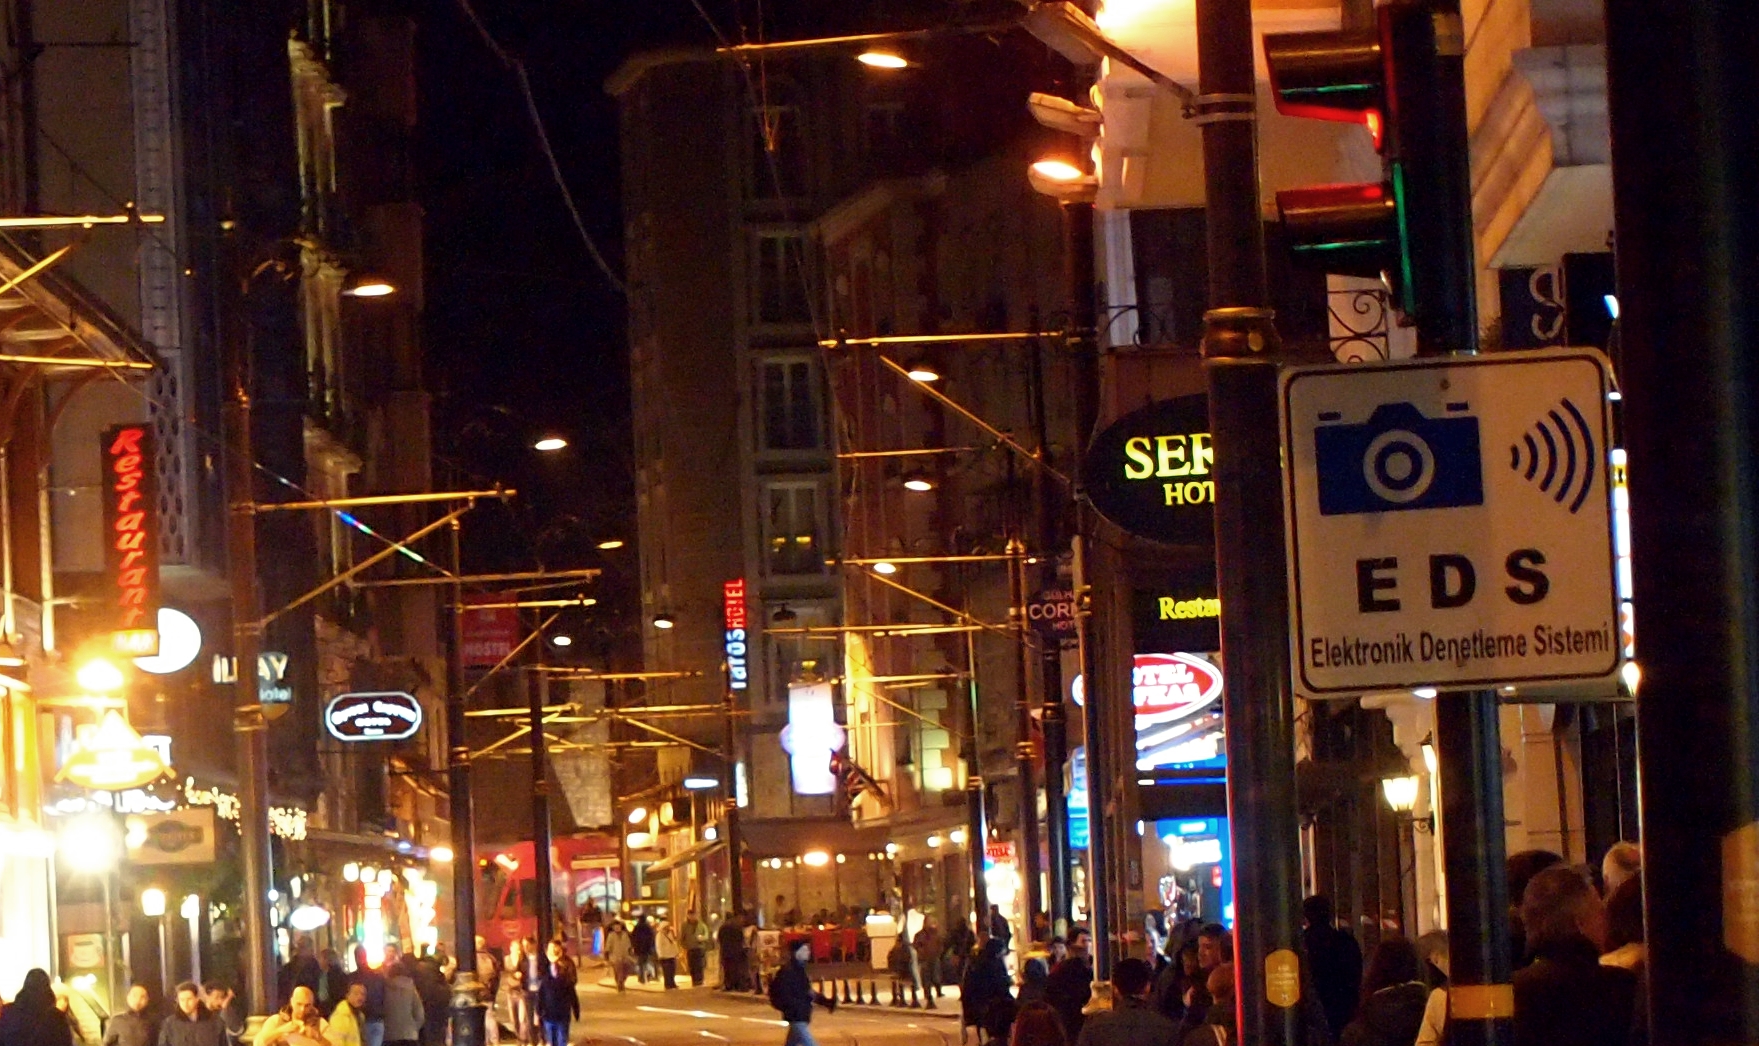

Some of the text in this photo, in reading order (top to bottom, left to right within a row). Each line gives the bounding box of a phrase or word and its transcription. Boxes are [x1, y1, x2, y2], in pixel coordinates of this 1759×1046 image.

[110, 429, 147, 628] Restaurant
[1311, 621, 1610, 668] Elektronik Denetleme Sistemi
